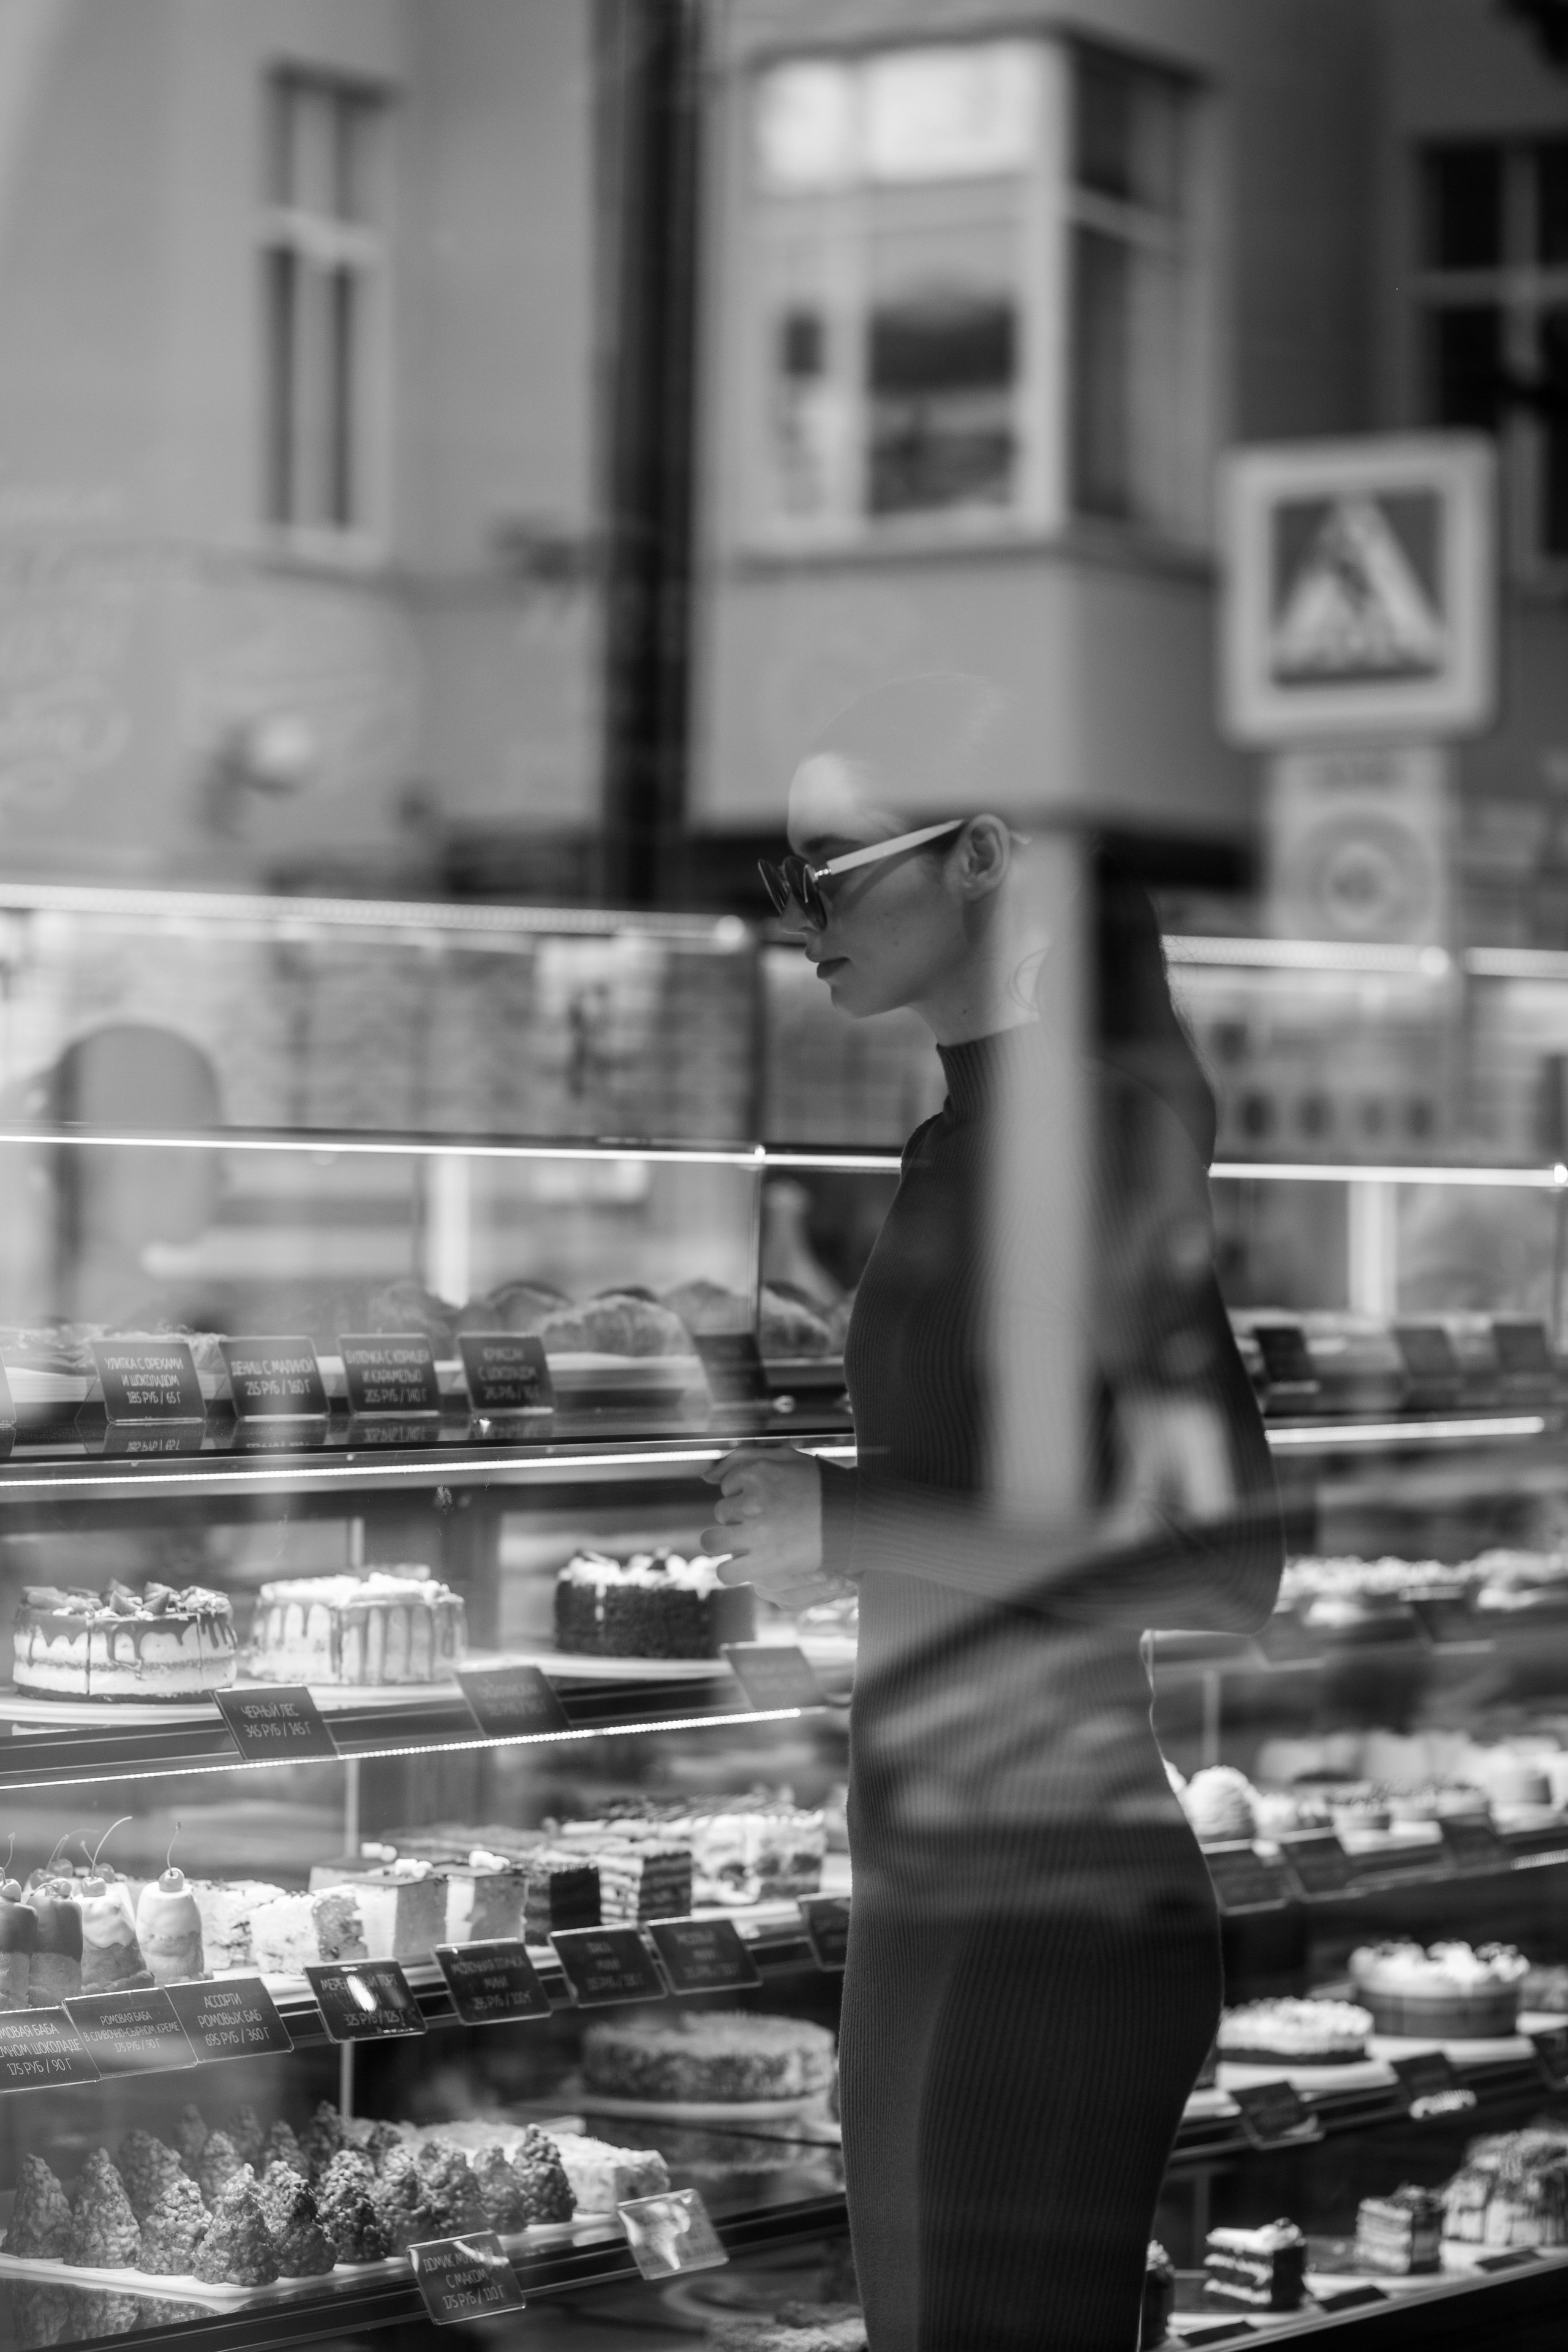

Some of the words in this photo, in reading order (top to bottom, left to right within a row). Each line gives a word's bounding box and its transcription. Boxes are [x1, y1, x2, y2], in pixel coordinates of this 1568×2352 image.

[144, 1357, 184, 1370] ОРЕХАМИ
[121, 1374, 129, 1387] И
[129, 1374, 180, 1388] ШОКОЛАДОМ
[260, 1380, 281, 1395] РУБ
[141, 1391, 159, 1404] РУБ
[166, 1391, 176, 1404] 65
[240, 1702, 281, 1719] ЧЕРНЫЙ
[279, 1703, 300, 1717] ЛЕС
[243, 1724, 263, 1738] 345
[261, 1723, 281, 1738] РУБ
[304, 1721, 312, 1735] Г
[203, 1992, 242, 2008] АССОРТИ
[100, 2013, 135, 2027] РОМОВАЯ
[132, 2010, 153, 2022] БАБА
[197, 2011, 245, 2029] РОМОВЫХ
[243, 2008, 263, 2023] БАБ
[31, 2022, 61, 2037] БАБА
[83, 2032, 90, 2042] В
[89, 2025, 157, 2042] СЛИВОЧНО-СЫРНОМ
[156, 2021, 181, 2034] КРЕМЕ
[205, 2033, 221, 2046] 695
[220, 2030, 239, 2045] РУБ
[246, 2027, 264, 2041] 360
[263, 2026, 270, 2040] Г
[0, 2043, 32, 2058] МНОМ
[29, 2038, 83, 2056] ШОКОЛАДЕ
[114, 2042, 127, 2053] 175
[125, 2040, 141, 2052] РУБ
[145, 2038, 156, 2049] 90
[154, 2037, 160, 2048] Г
[6, 2062, 24, 2076] 175
[23, 2060, 44, 2075] РУБ
[46, 2058, 50, 2074] /
[51, 2058, 66, 2071] 90
[65, 2057, 72, 2070] Г
[423, 2254, 456, 2273] ДОМИК
[445, 2274, 455, 2288] С
[454, 2268, 489, 2286] МАКОМ
[442, 2295, 459, 2310] 175
[457, 2291, 477, 2307] РУБ
[497, 2285, 504, 2299] Г
